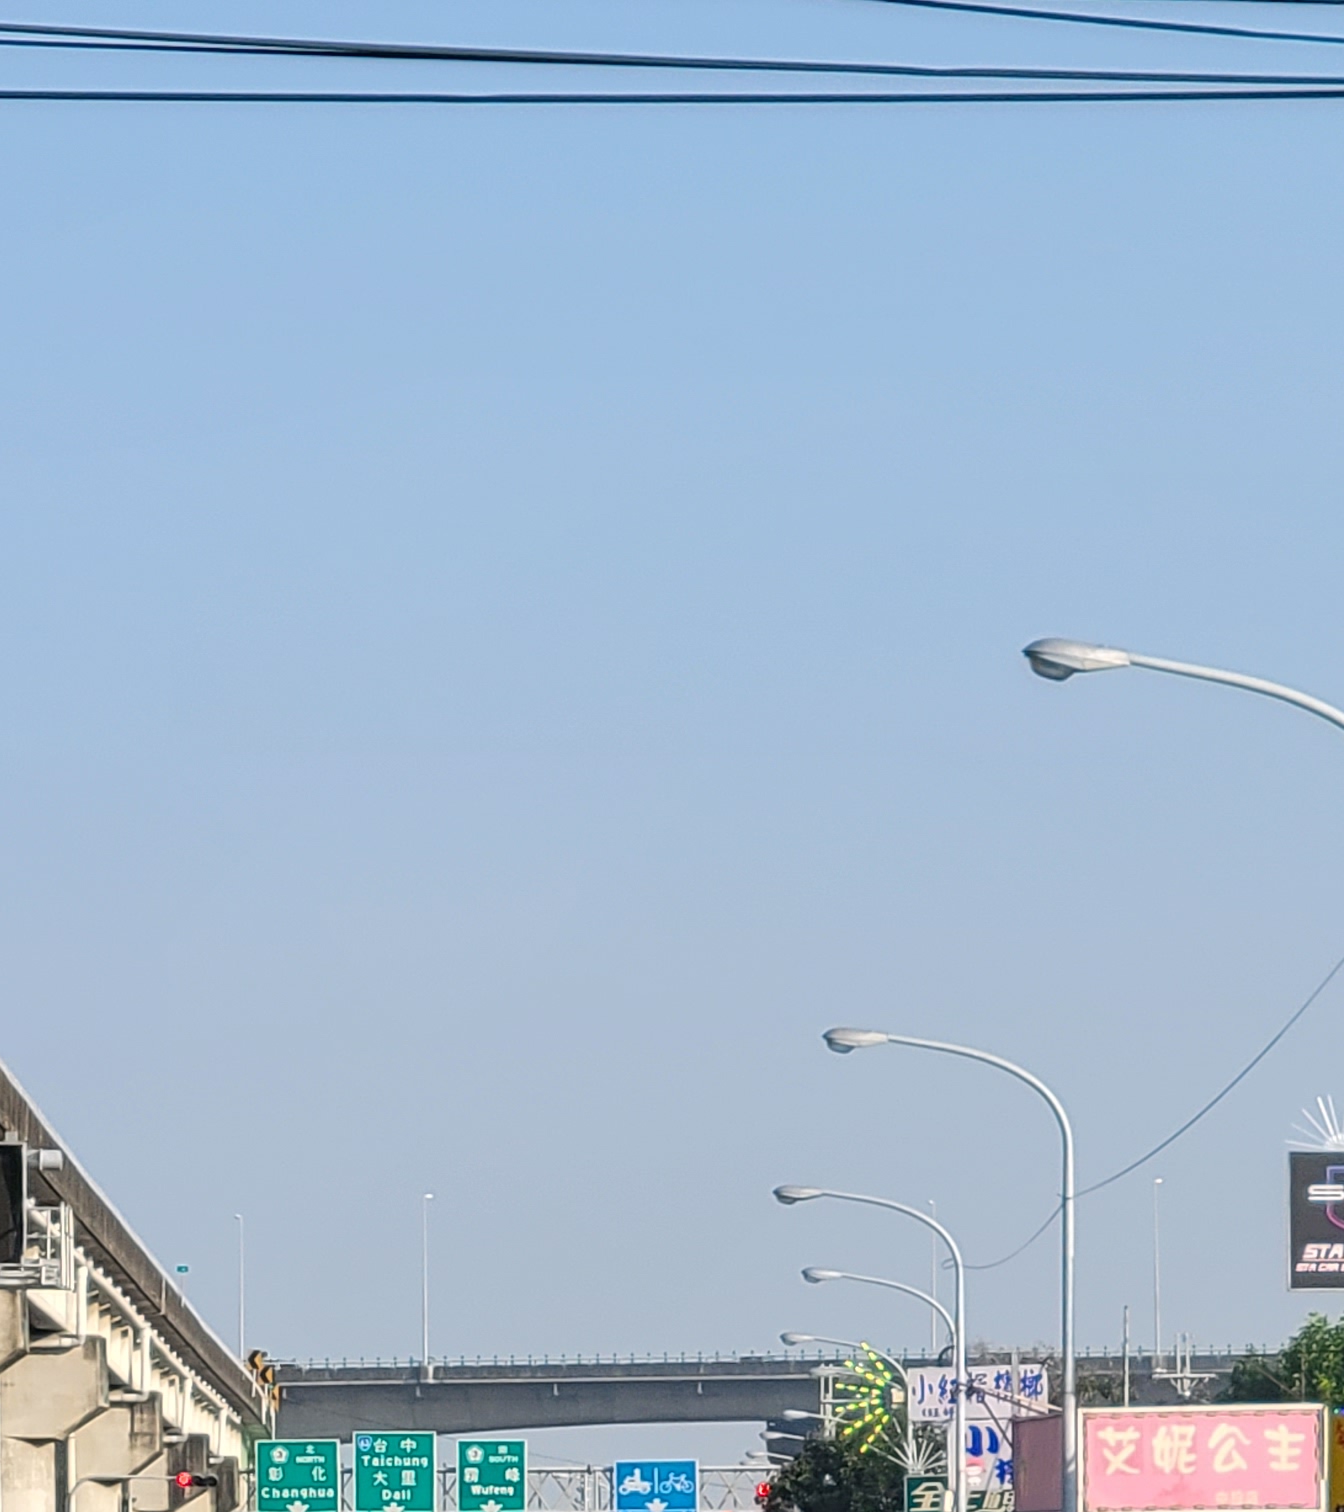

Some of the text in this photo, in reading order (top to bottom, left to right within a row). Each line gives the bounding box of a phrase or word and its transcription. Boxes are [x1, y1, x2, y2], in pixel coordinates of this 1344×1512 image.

[373, 1437, 417, 1454] 台中
[1096, 1423, 1307, 1475] 艾妮公主
[361, 1454, 429, 1468] Taichung
[372, 1470, 417, 1487] 大里
[260, 1487, 335, 1500] Changhua
[470, 1484, 515, 1497] Wufeng
